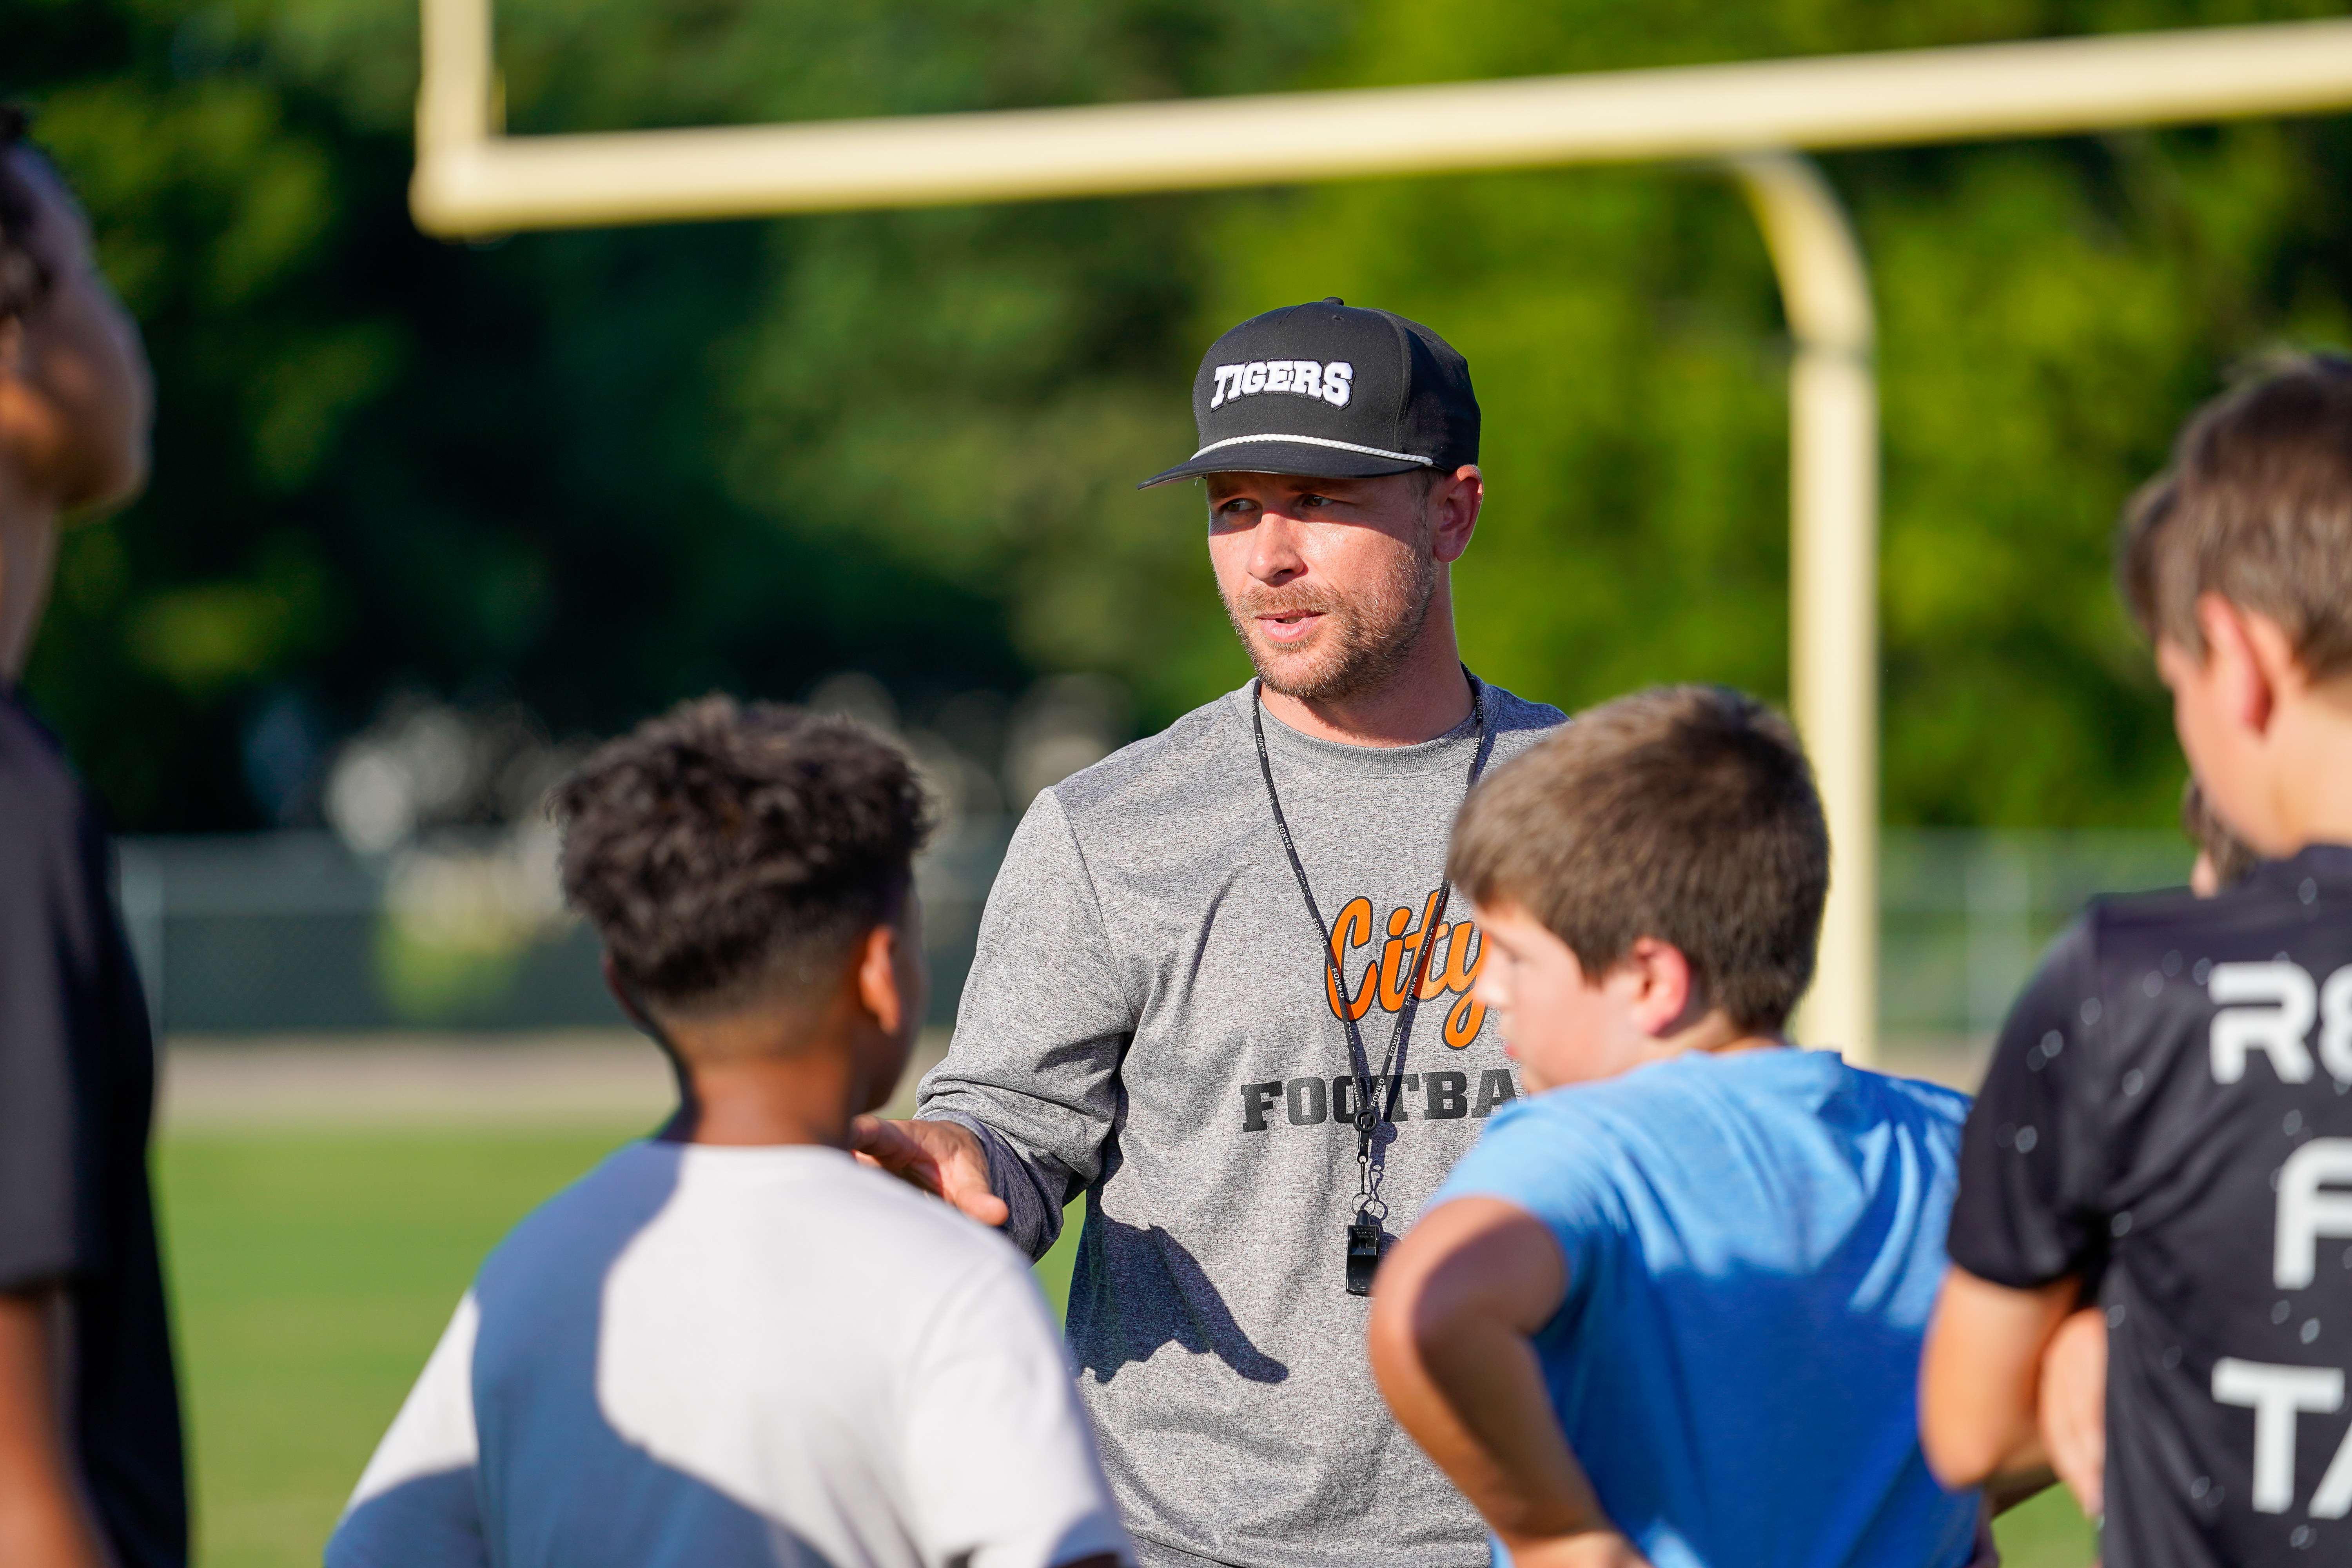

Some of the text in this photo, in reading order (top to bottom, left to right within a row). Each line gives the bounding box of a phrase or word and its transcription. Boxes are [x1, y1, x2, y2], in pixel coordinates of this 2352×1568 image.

[1211, 360, 1354, 408] TIGERS
[1278, 823, 1292, 849] FOX40
[1325, 888, 1492, 1050] City
[1331, 968, 1345, 998] FOX40
[1371, 1078, 1385, 1107] FOX40
